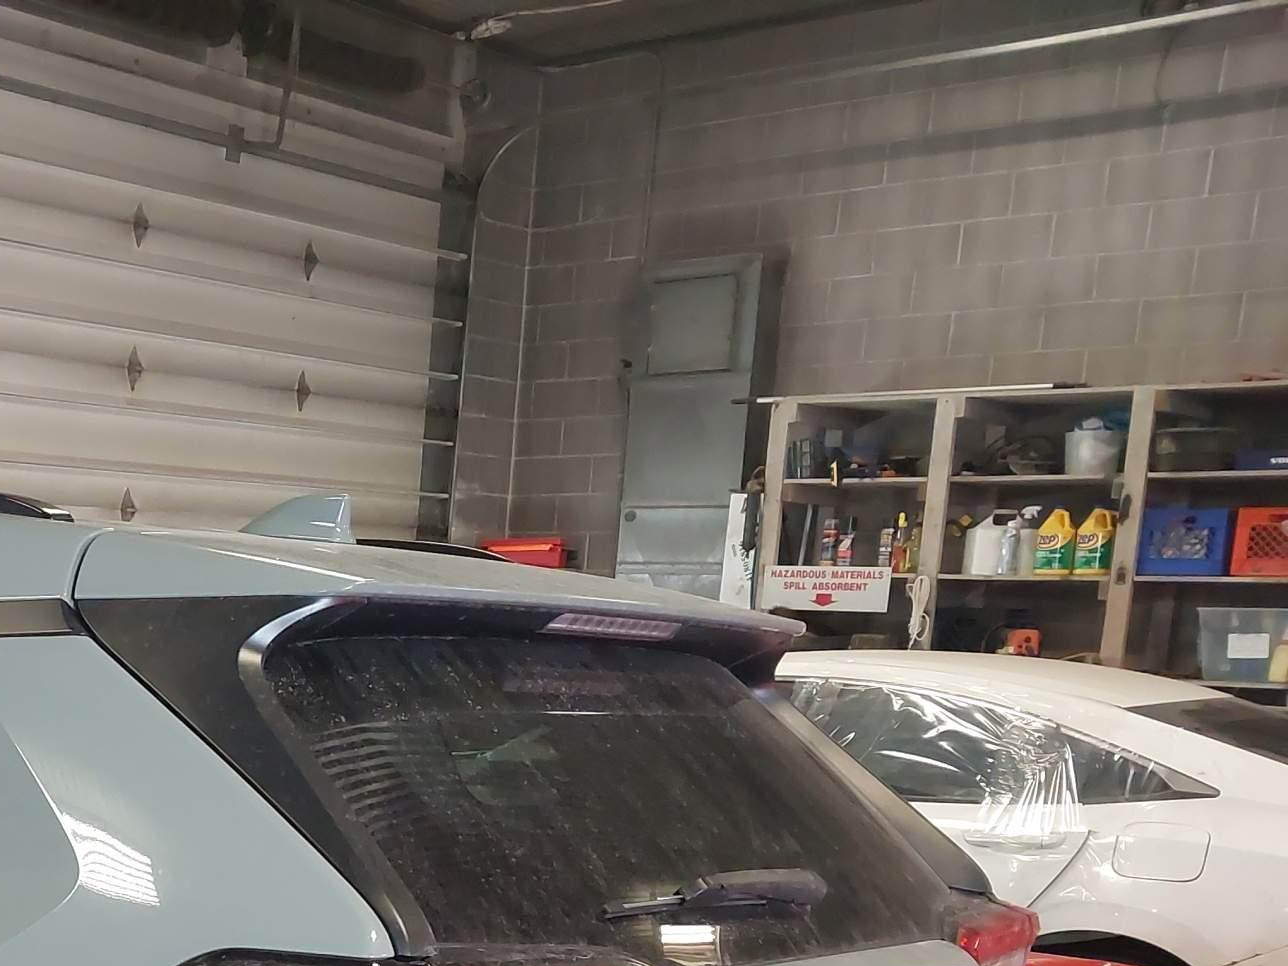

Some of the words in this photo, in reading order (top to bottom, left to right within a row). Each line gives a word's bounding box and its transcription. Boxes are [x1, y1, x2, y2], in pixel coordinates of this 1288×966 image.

[770, 570, 827, 579] HAZARDOUS
[831, 570, 884, 580] MATERIALS
[783, 581, 807, 591] SPILL
[812, 582, 869, 592] ABSORBENT
